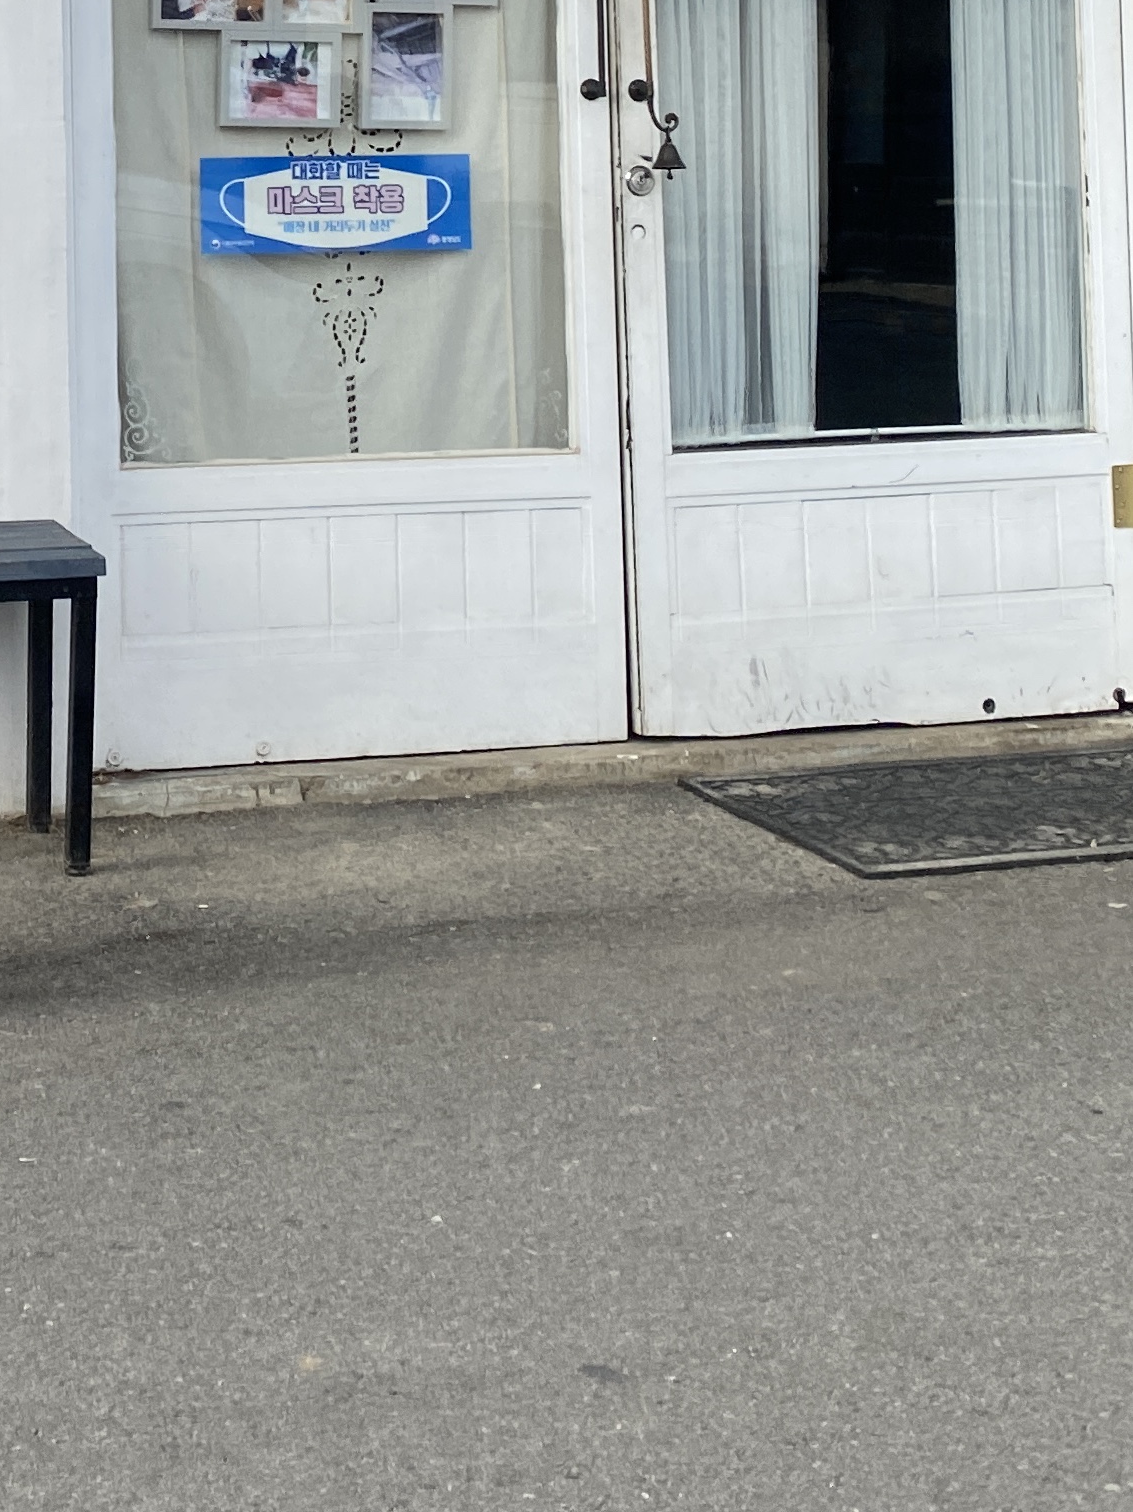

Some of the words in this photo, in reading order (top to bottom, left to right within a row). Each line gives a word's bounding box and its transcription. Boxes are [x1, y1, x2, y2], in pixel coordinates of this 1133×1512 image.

[290, 160, 342, 181] 대화할
[347, 160, 381, 181] 때는
[267, 184, 344, 216] 마스크
[353, 183, 405, 215] 착용
[323, 219, 366, 233] 거리두기
